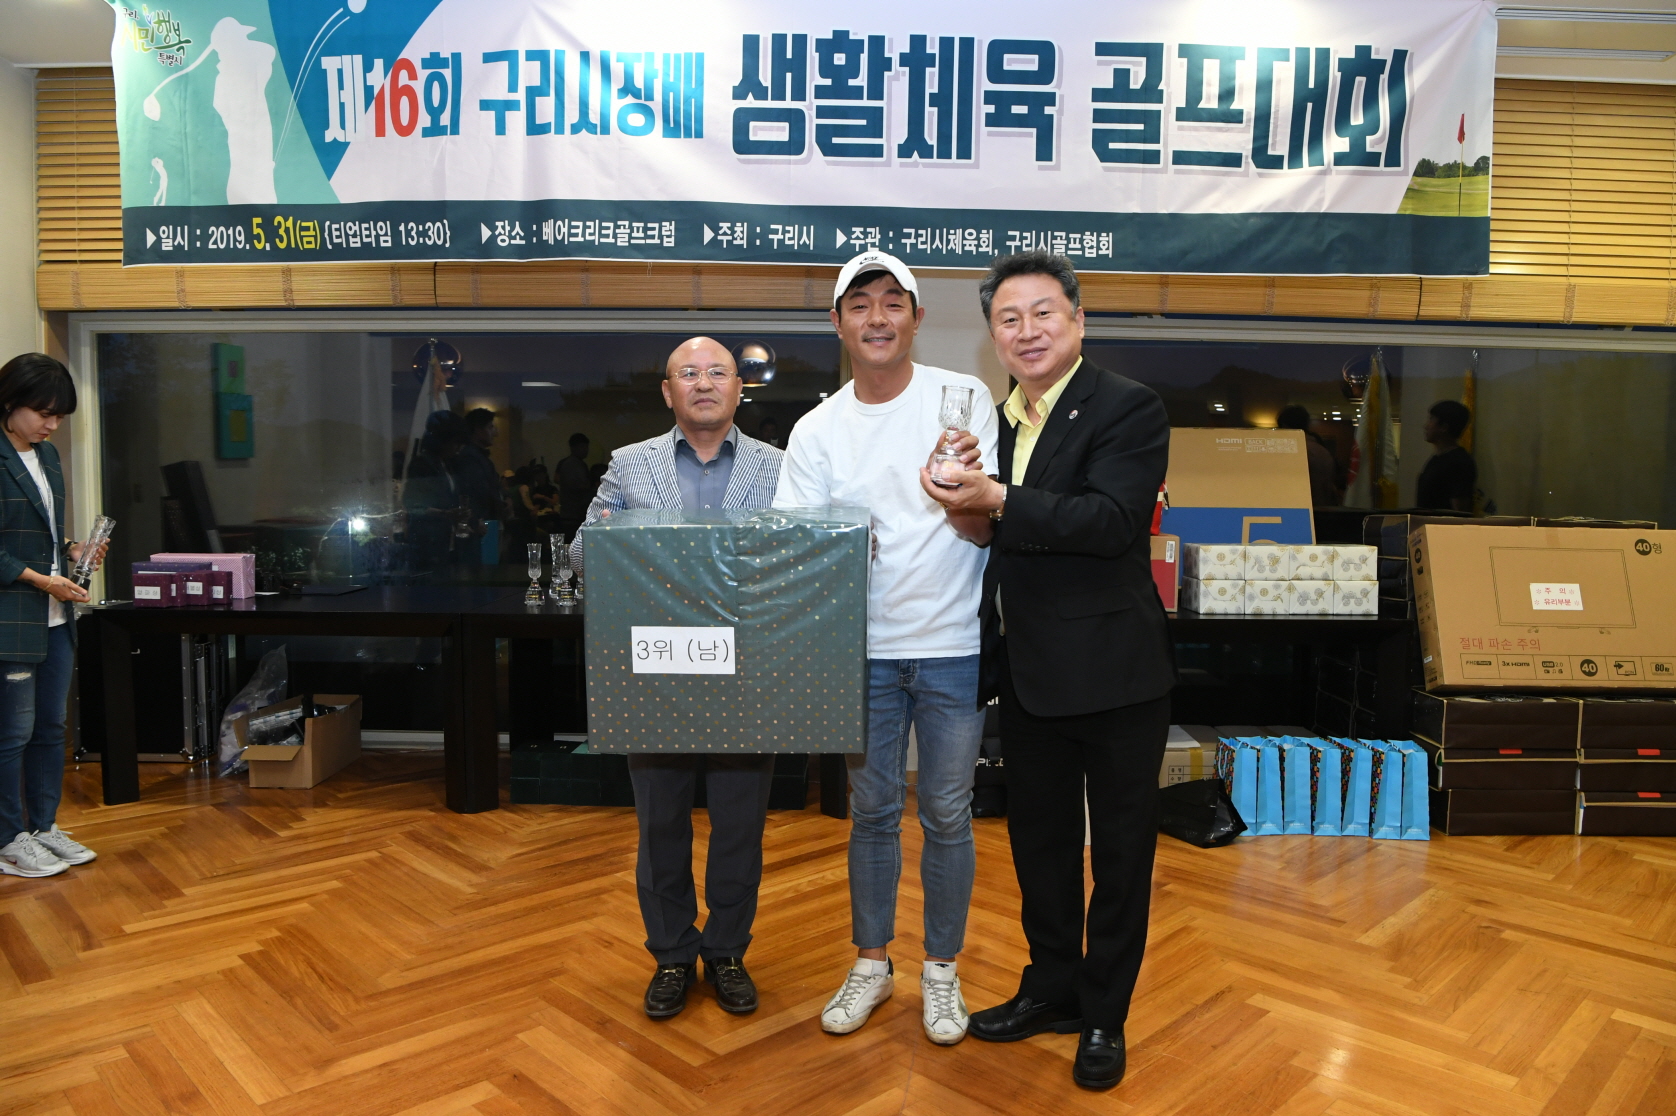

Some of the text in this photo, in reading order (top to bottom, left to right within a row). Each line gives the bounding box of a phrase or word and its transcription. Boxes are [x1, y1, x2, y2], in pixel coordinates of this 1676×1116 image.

[158, 52, 182, 67] 특별시
[320, 29, 1409, 171] 제16회 구리시장배 생활체육 골프대회
[159, 225, 189, 251] 일시
[208, 225, 250, 250] 2019.
[252, 215, 271, 251] 5.
[274, 215, 321, 251] 31(금)
[494, 220, 526, 247] 장소
[542, 218, 676, 247] 베어크리크골프크럽
[716, 222, 748, 249] 주최
[768, 224, 814, 251] 구리시
[849, 226, 882, 253] 주관
[901, 226, 999, 257] 구리시체육회,
[1005, 229, 1113, 259] 구리시골프협회
[1544, 598, 1571, 606] 유리부분
[636, 638, 729, 663] 3위 (남)
[1459, 637, 1541, 651] 절대 파손 주의
[1581, 663, 1597, 673] 40
